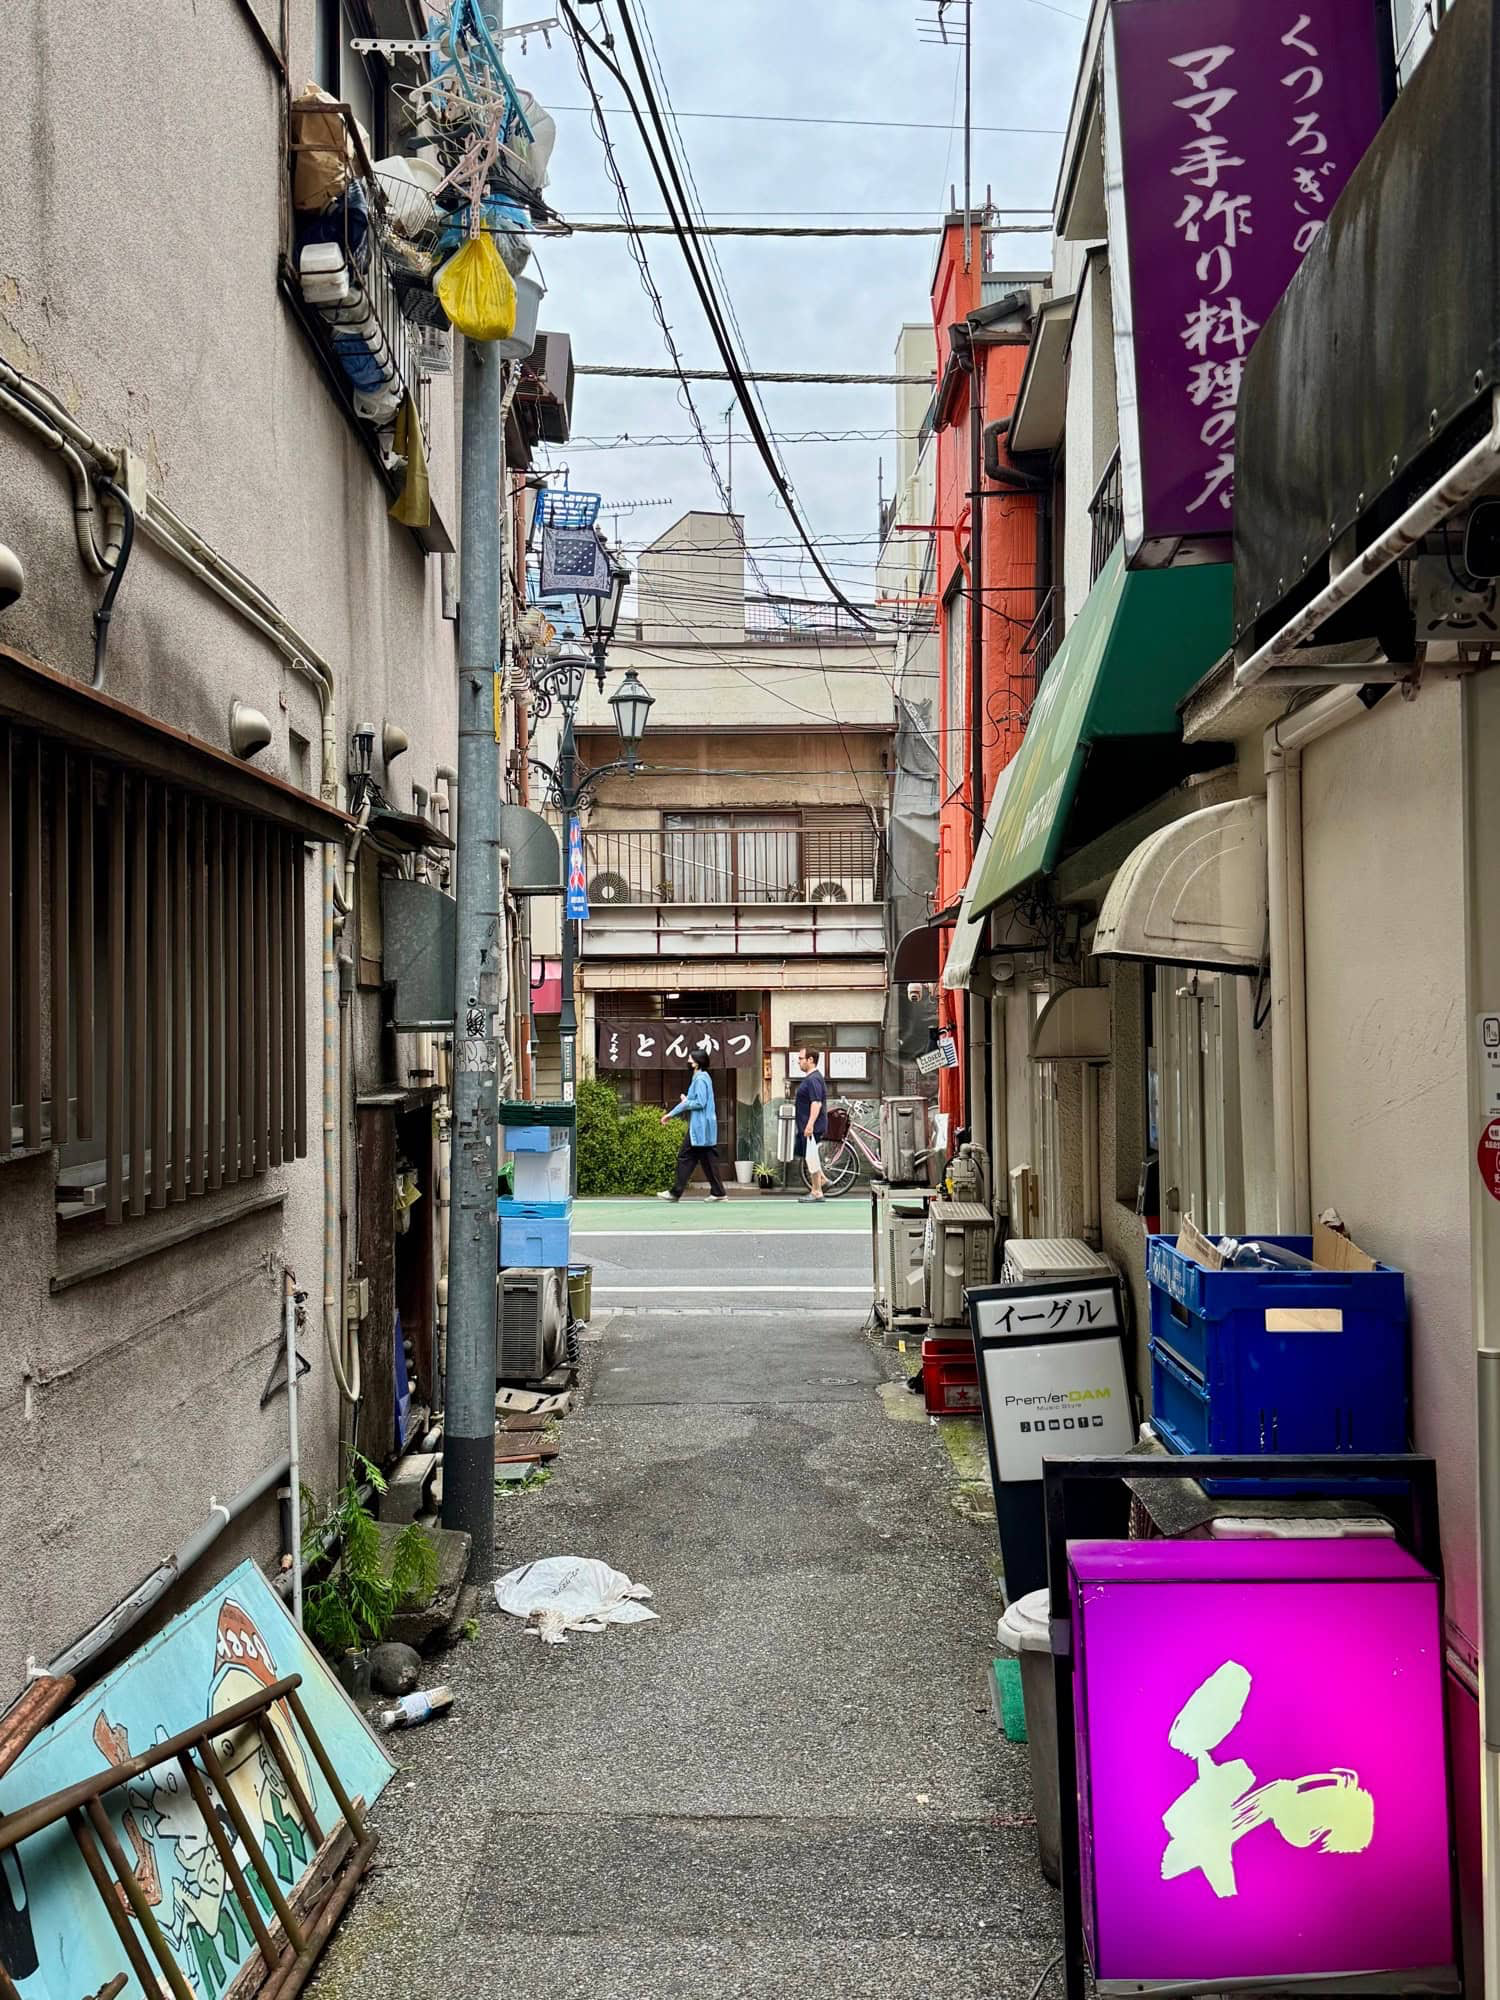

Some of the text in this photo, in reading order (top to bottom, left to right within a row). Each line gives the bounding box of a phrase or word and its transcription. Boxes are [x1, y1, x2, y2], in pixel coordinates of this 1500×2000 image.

[637, 1033, 752, 1058] とんかつ
[994, 1299, 1103, 1332] イーグル
